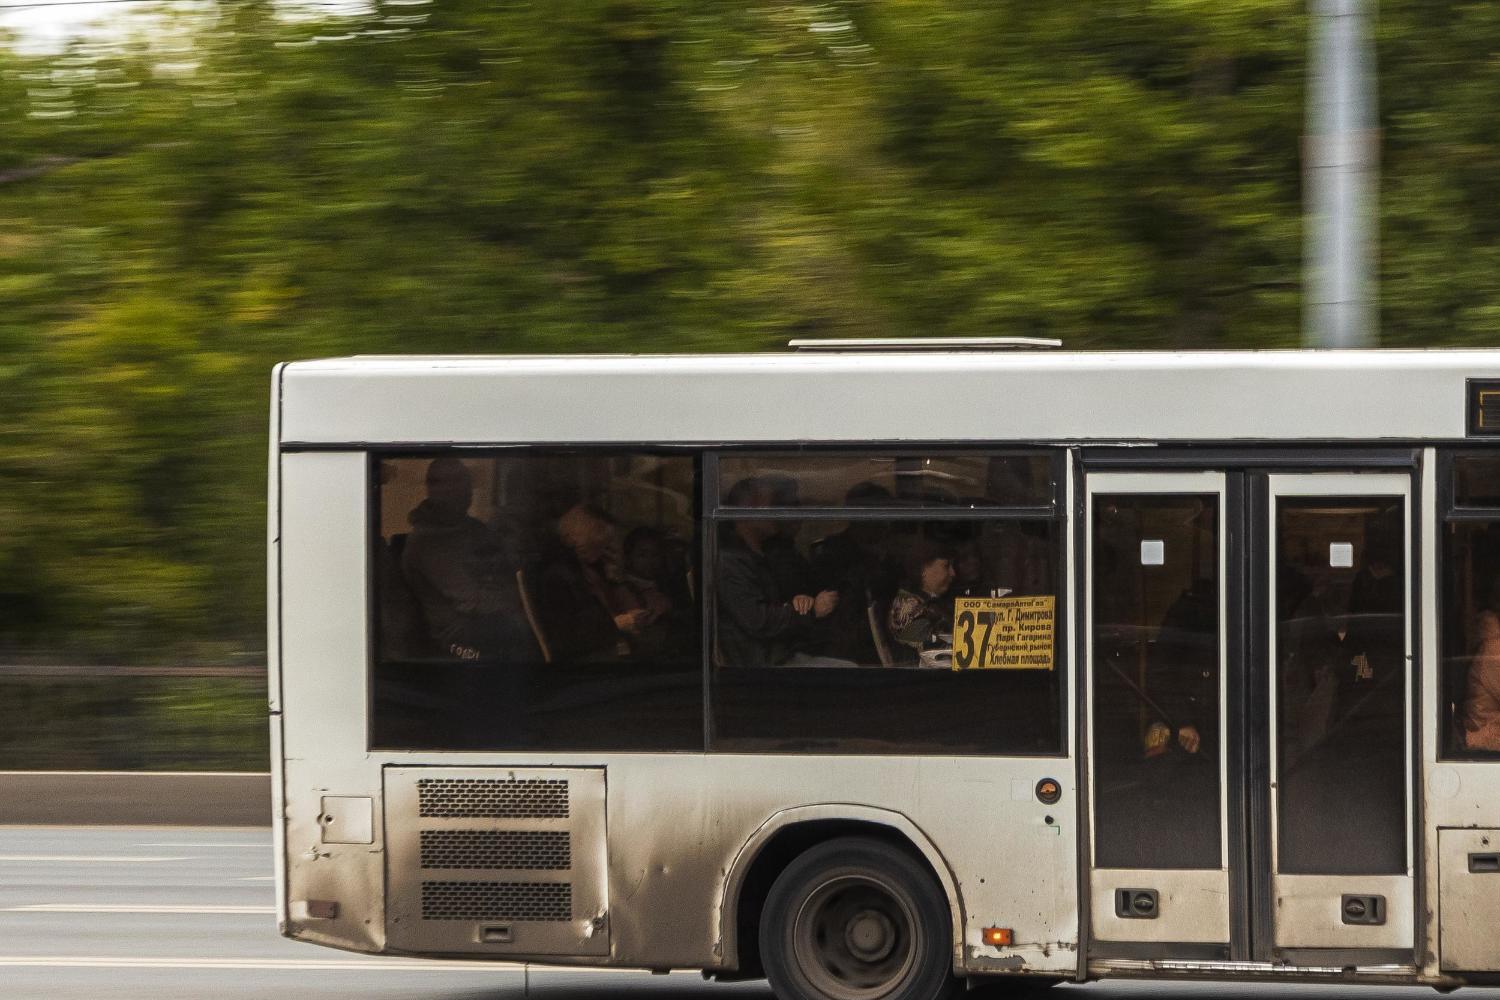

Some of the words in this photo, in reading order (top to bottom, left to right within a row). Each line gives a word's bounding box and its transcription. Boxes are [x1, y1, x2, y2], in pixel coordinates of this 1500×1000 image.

[1015, 609, 1052, 623] Димитрова
[1018, 624, 1052, 632] Кирова
[956, 611, 996, 667] 37
[996, 633, 1015, 642] Парк
[1017, 633, 1052, 642] Гагарина
[1029, 643, 1052, 653] рынок
[989, 652, 1019, 666] Хлебная
[1020, 654, 1051, 665] площадь
